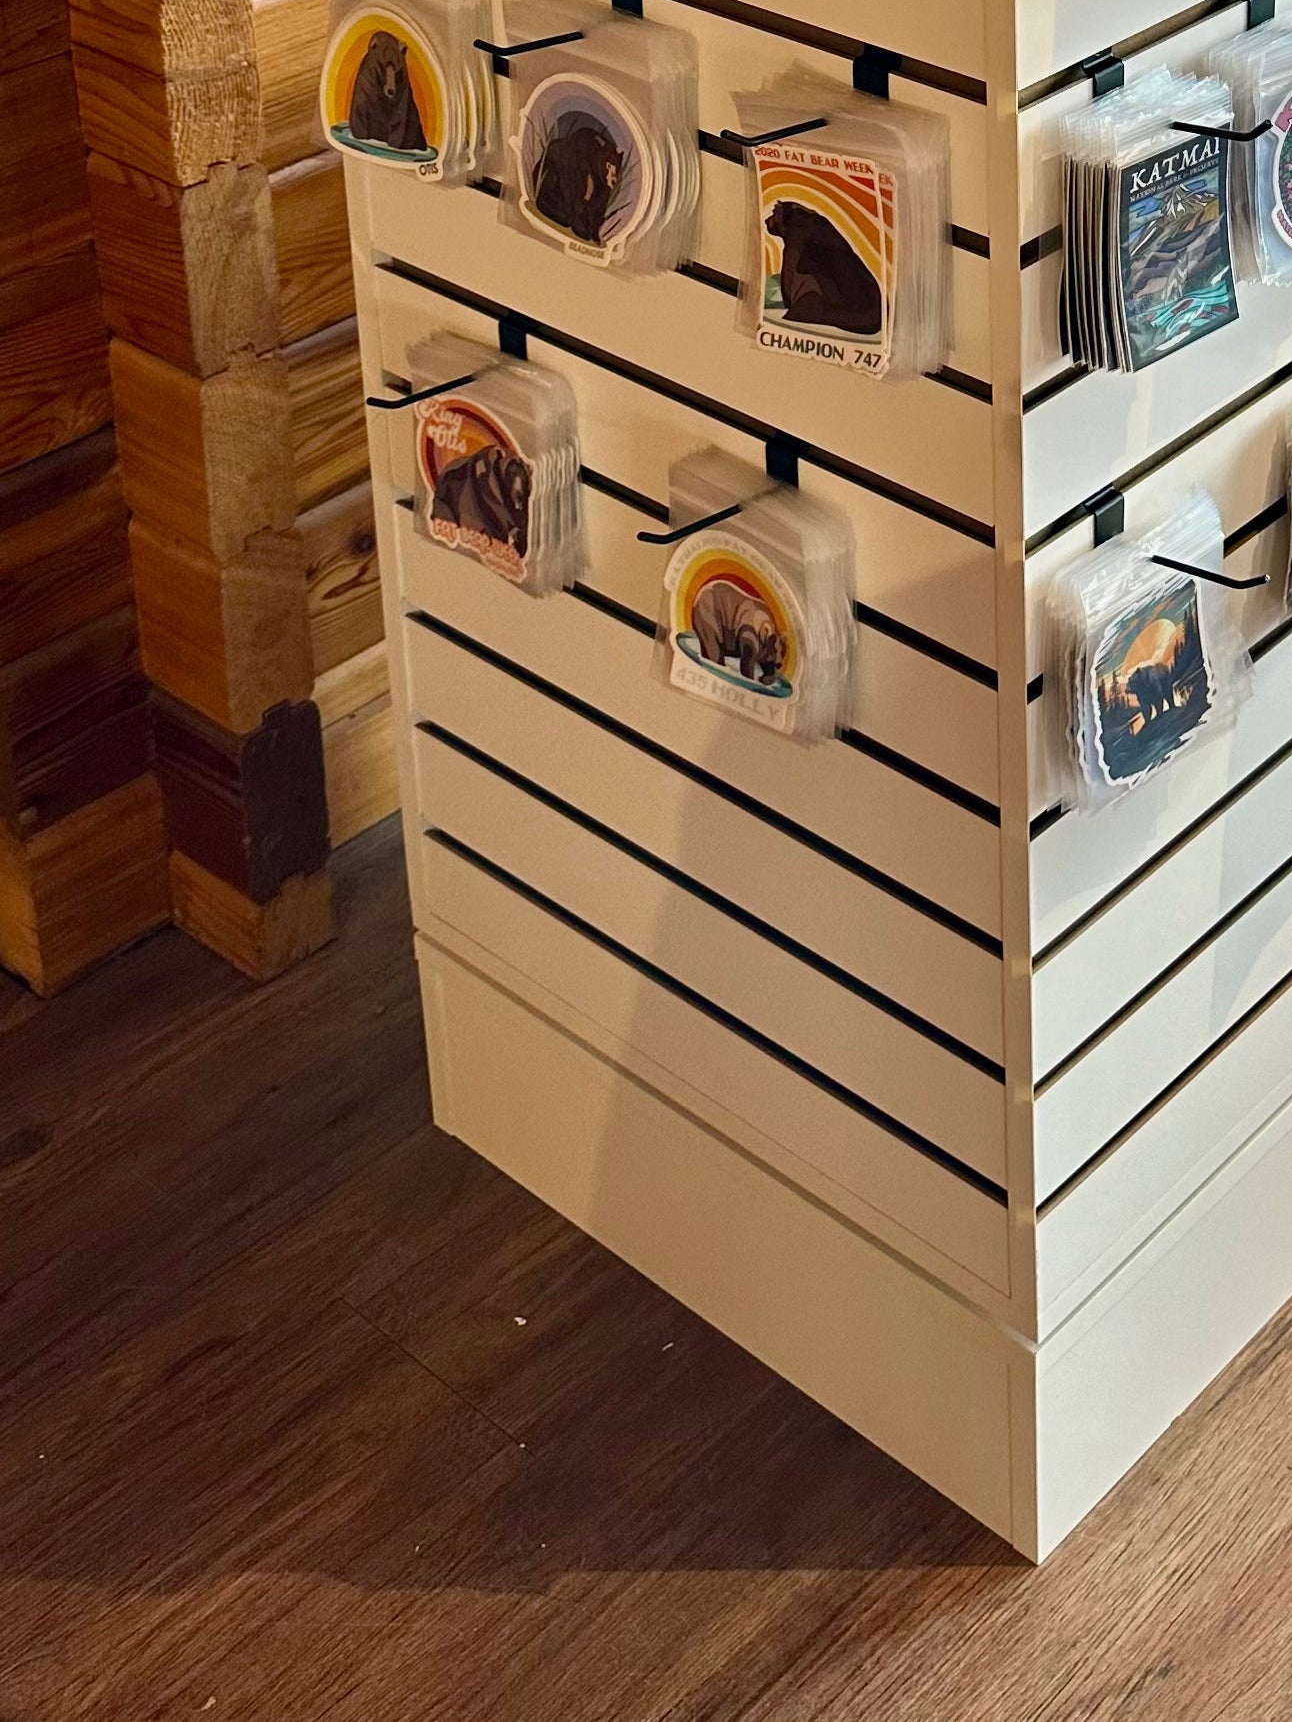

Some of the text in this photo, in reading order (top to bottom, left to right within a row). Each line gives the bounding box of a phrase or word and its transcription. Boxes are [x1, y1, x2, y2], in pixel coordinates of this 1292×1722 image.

[755, 146, 874, 175] 2020 FAT BEAR WEEK
[1130, 137, 1220, 194] KATMAI
[1130, 182, 1165, 202] NATIONAL
[760, 331, 881, 367] CHAMPION 747
[711, 685, 783, 719] HOLLY
